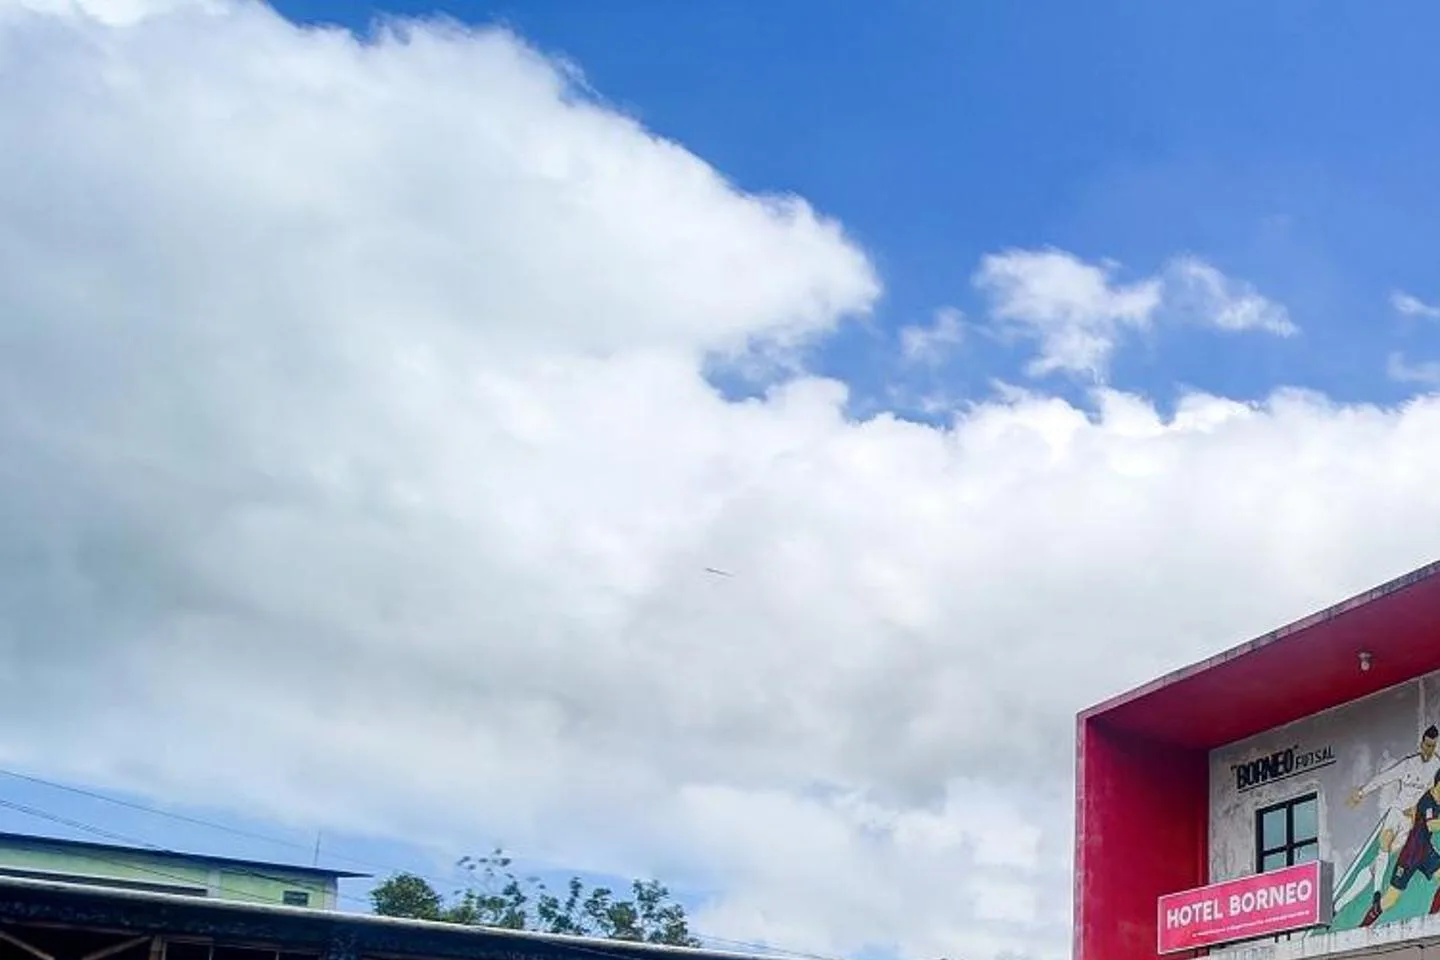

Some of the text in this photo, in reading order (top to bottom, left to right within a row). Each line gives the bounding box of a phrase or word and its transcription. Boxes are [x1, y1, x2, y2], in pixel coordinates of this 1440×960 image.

[1296, 745, 1336, 770] FUTSAL
[1166, 900, 1224, 929] HOTEL
[1229, 879, 1313, 917] BORNEO
